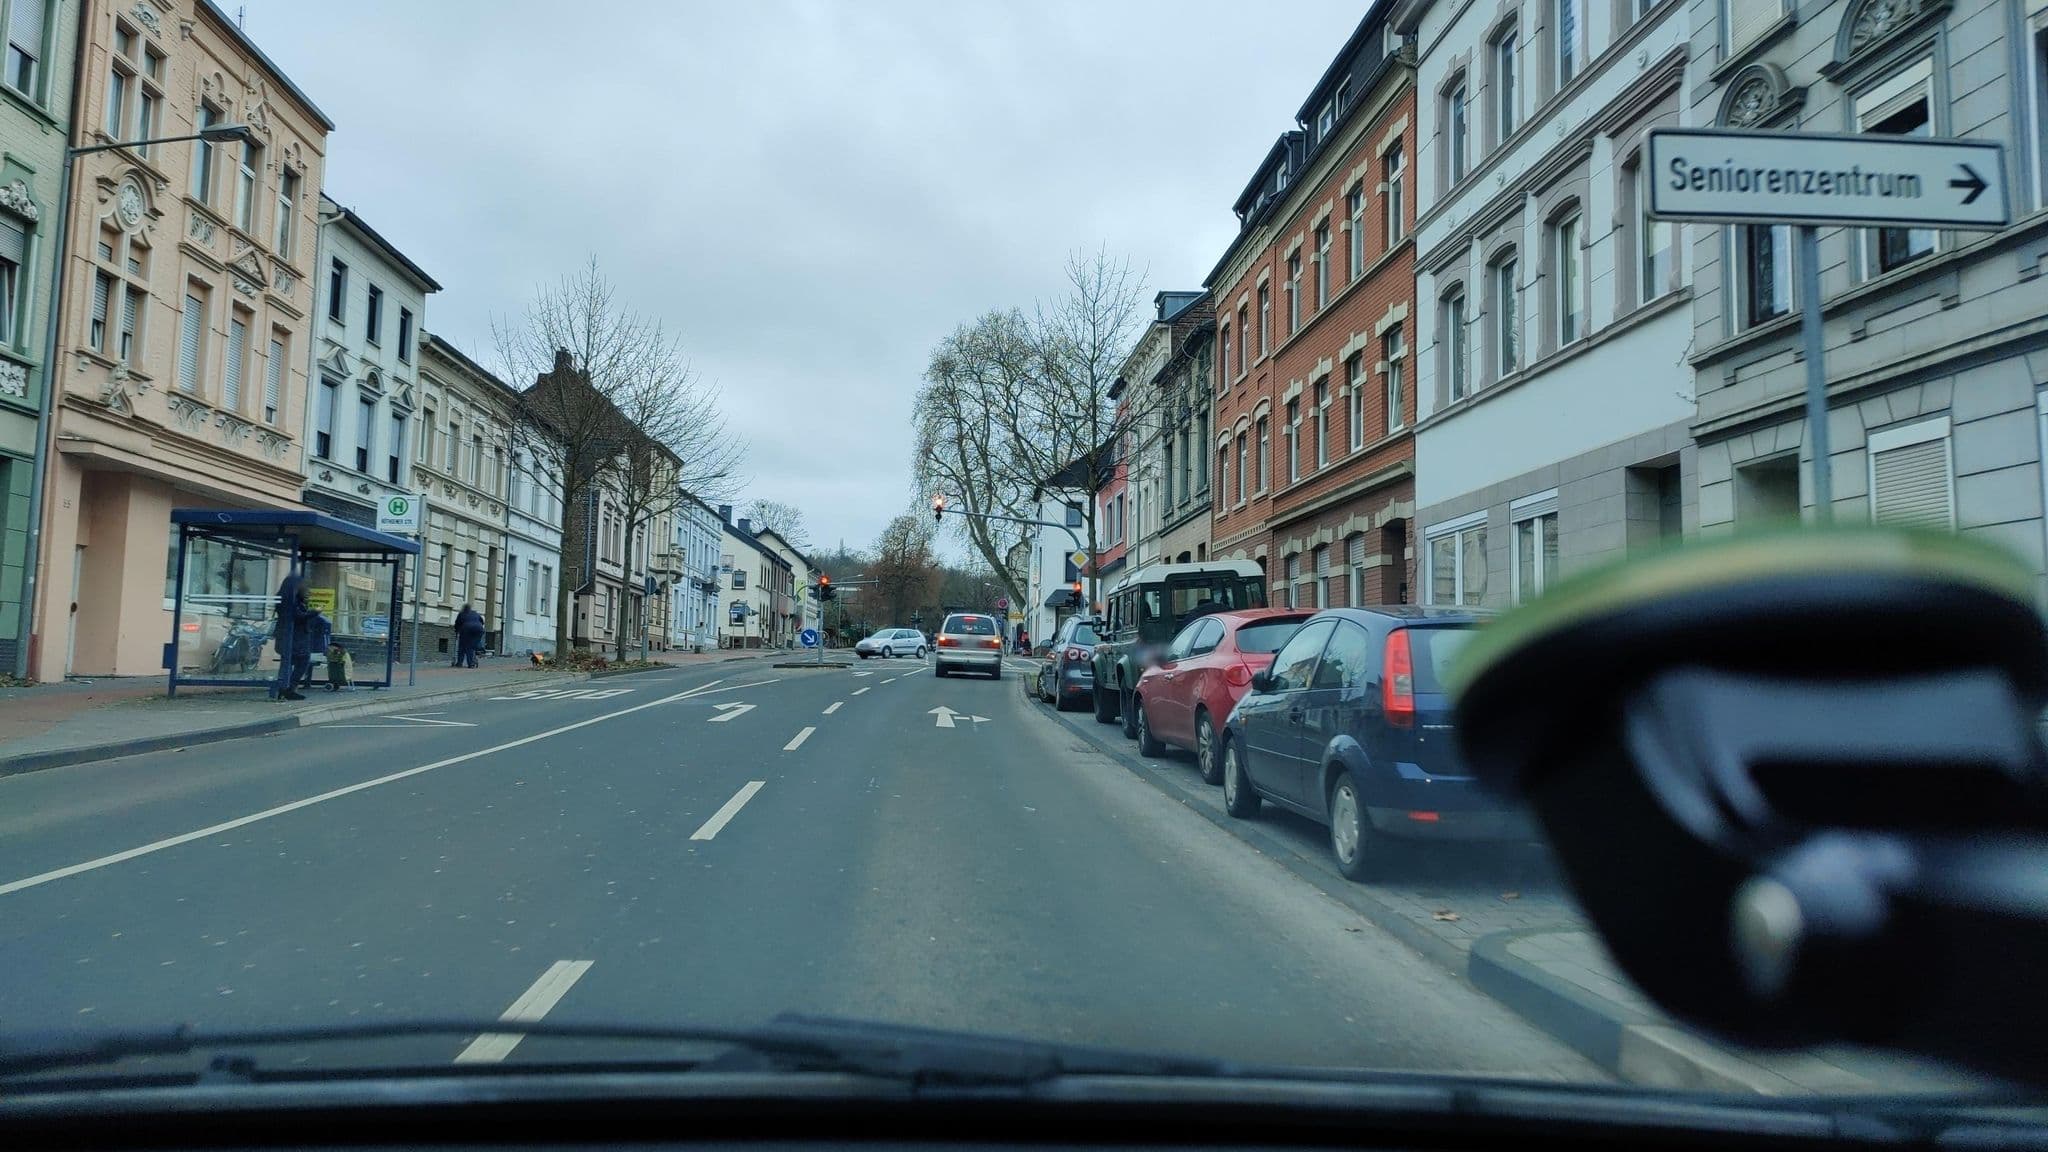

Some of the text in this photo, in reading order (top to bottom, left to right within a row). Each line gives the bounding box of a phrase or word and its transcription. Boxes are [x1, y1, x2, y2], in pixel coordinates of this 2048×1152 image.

[1669, 156, 1922, 199] Seniorenzentrum
[393, 501, 404, 512] H
[487, 689, 636, 700] BUS
